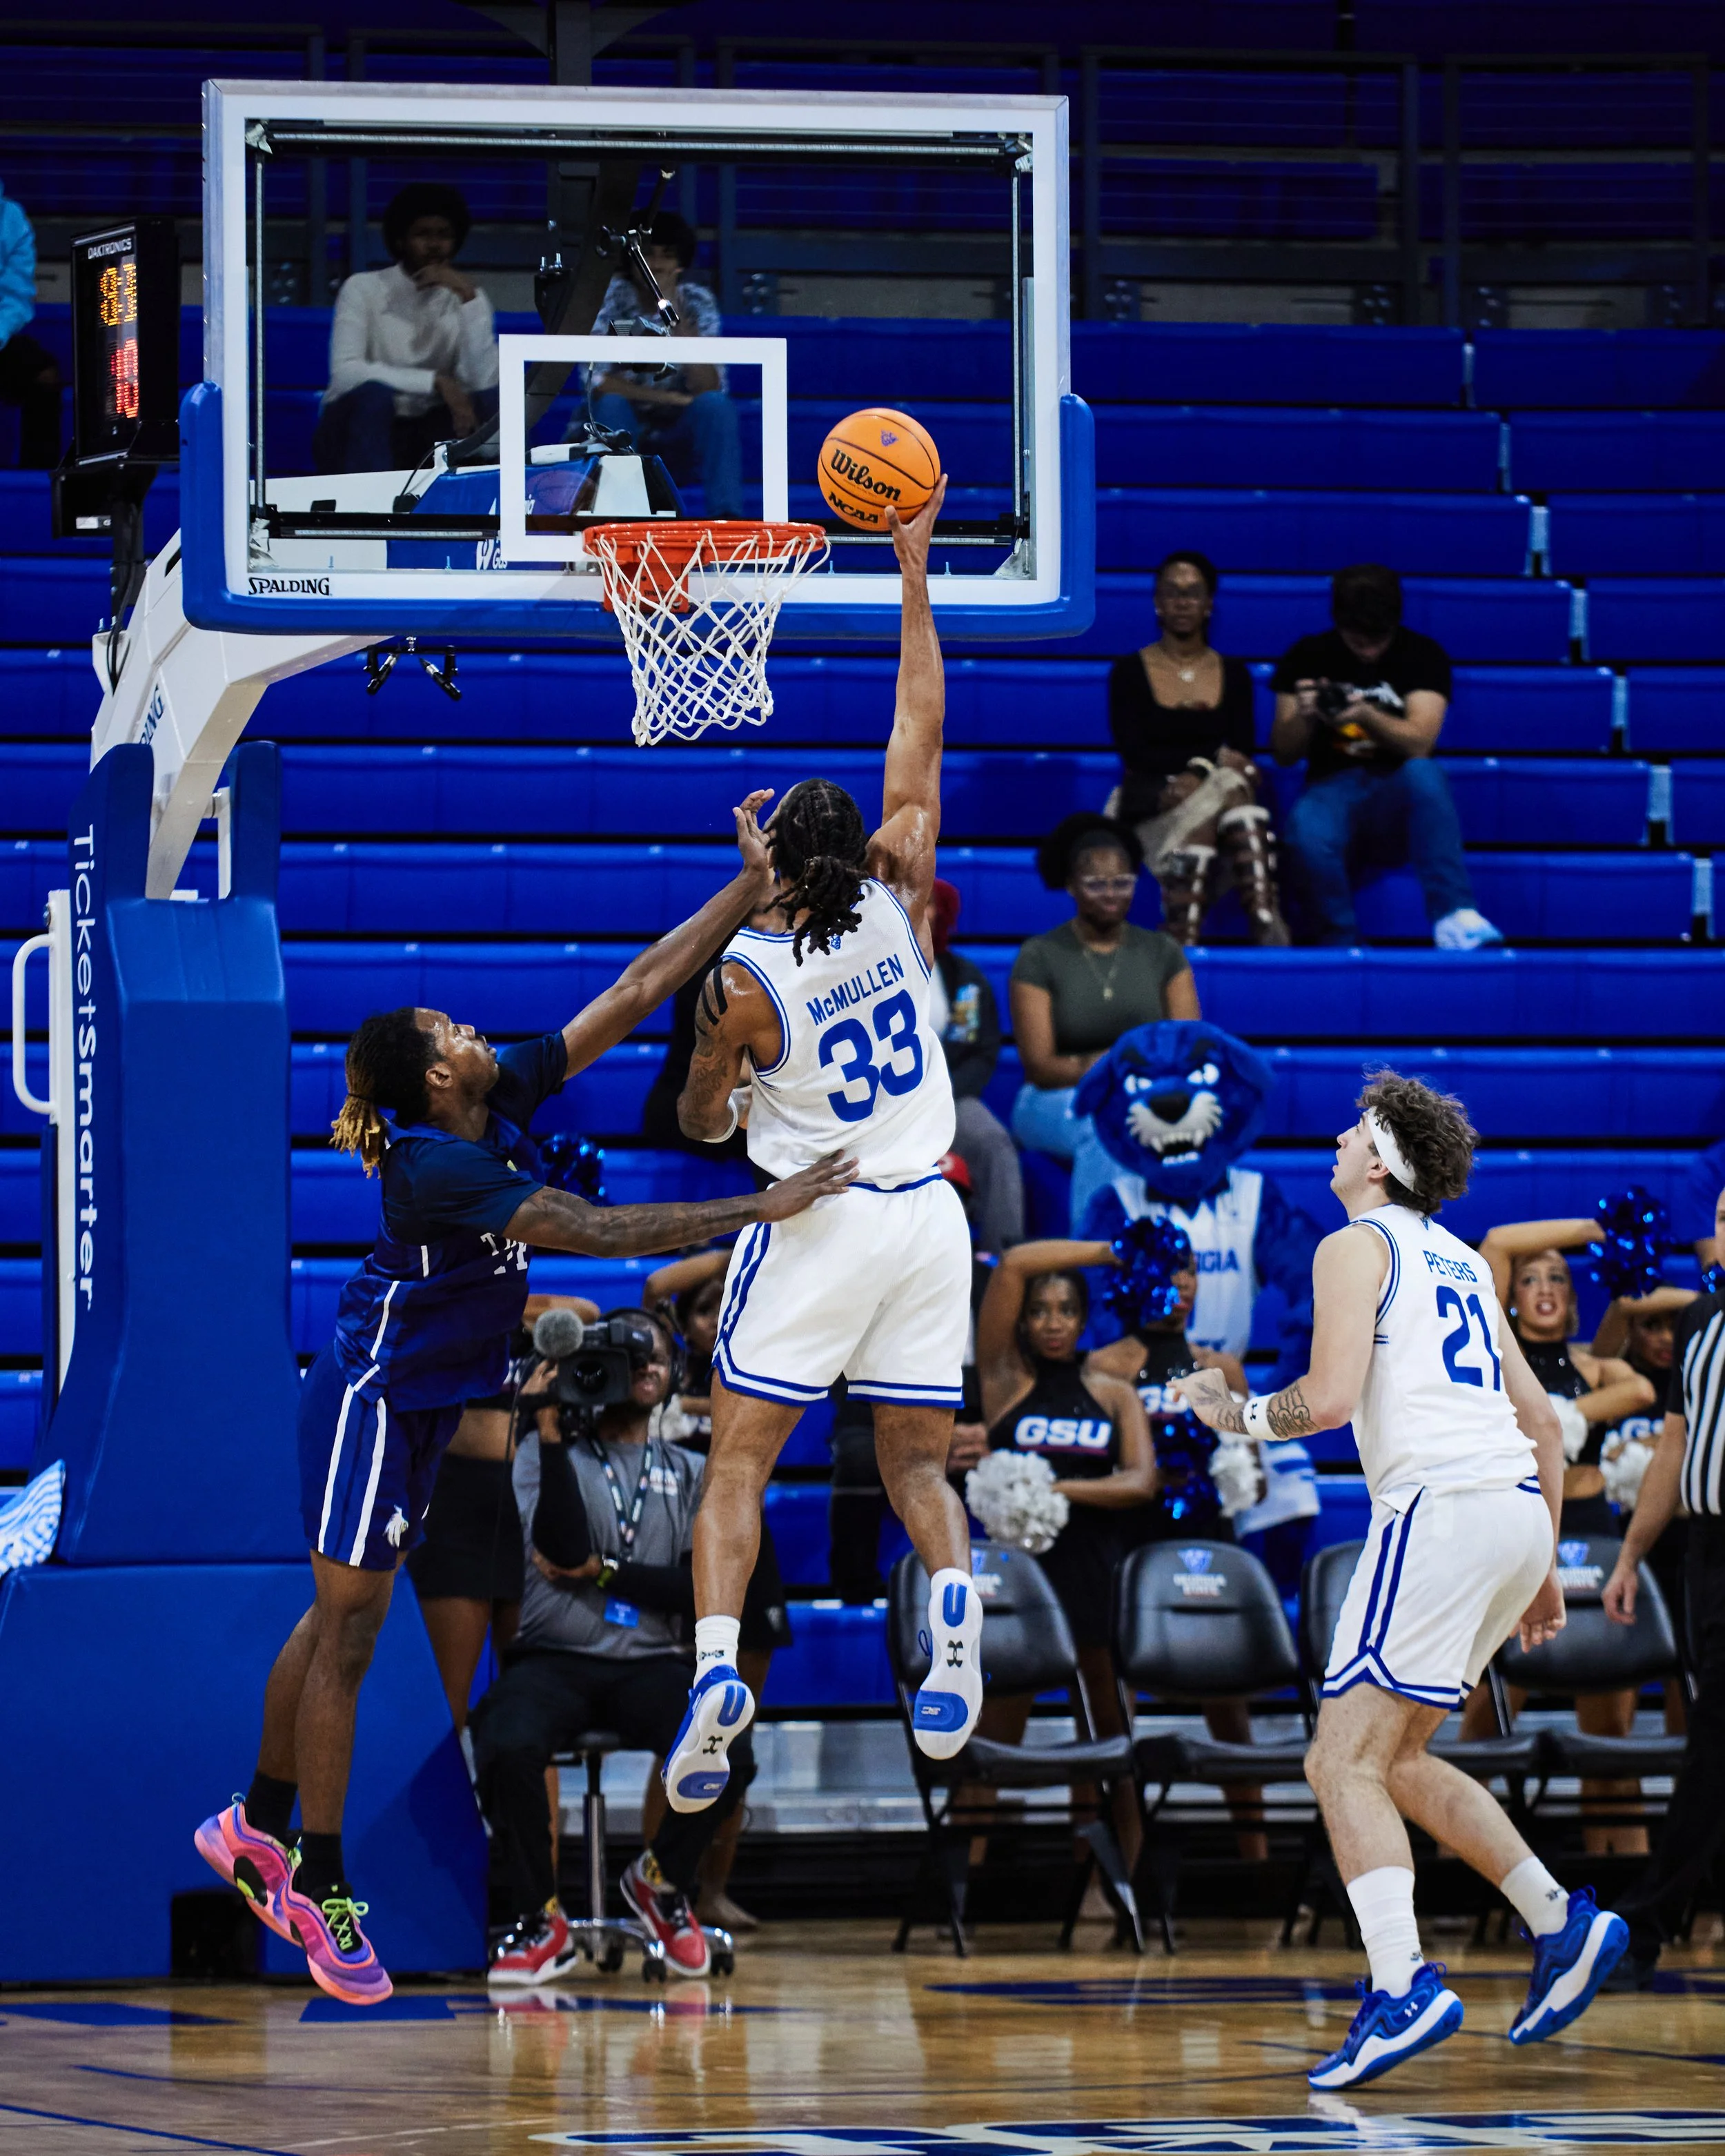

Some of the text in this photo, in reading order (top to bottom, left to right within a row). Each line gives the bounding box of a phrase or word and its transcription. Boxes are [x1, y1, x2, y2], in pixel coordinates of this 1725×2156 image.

[88, 238, 132, 259] DAKTRONICS
[830, 448, 901, 502] Wilson
[828, 491, 879, 524] NCAA
[248, 576, 330, 596] SPALDING
[806, 953, 905, 1027] McMULLEN
[74, 823, 97, 1312] TicketSmarter
[818, 989, 923, 1122] 33
[1422, 1249, 1478, 1283] PETERS
[1436, 1285, 1501, 1392] 21
[1014, 1415, 1112, 1448] GSU
